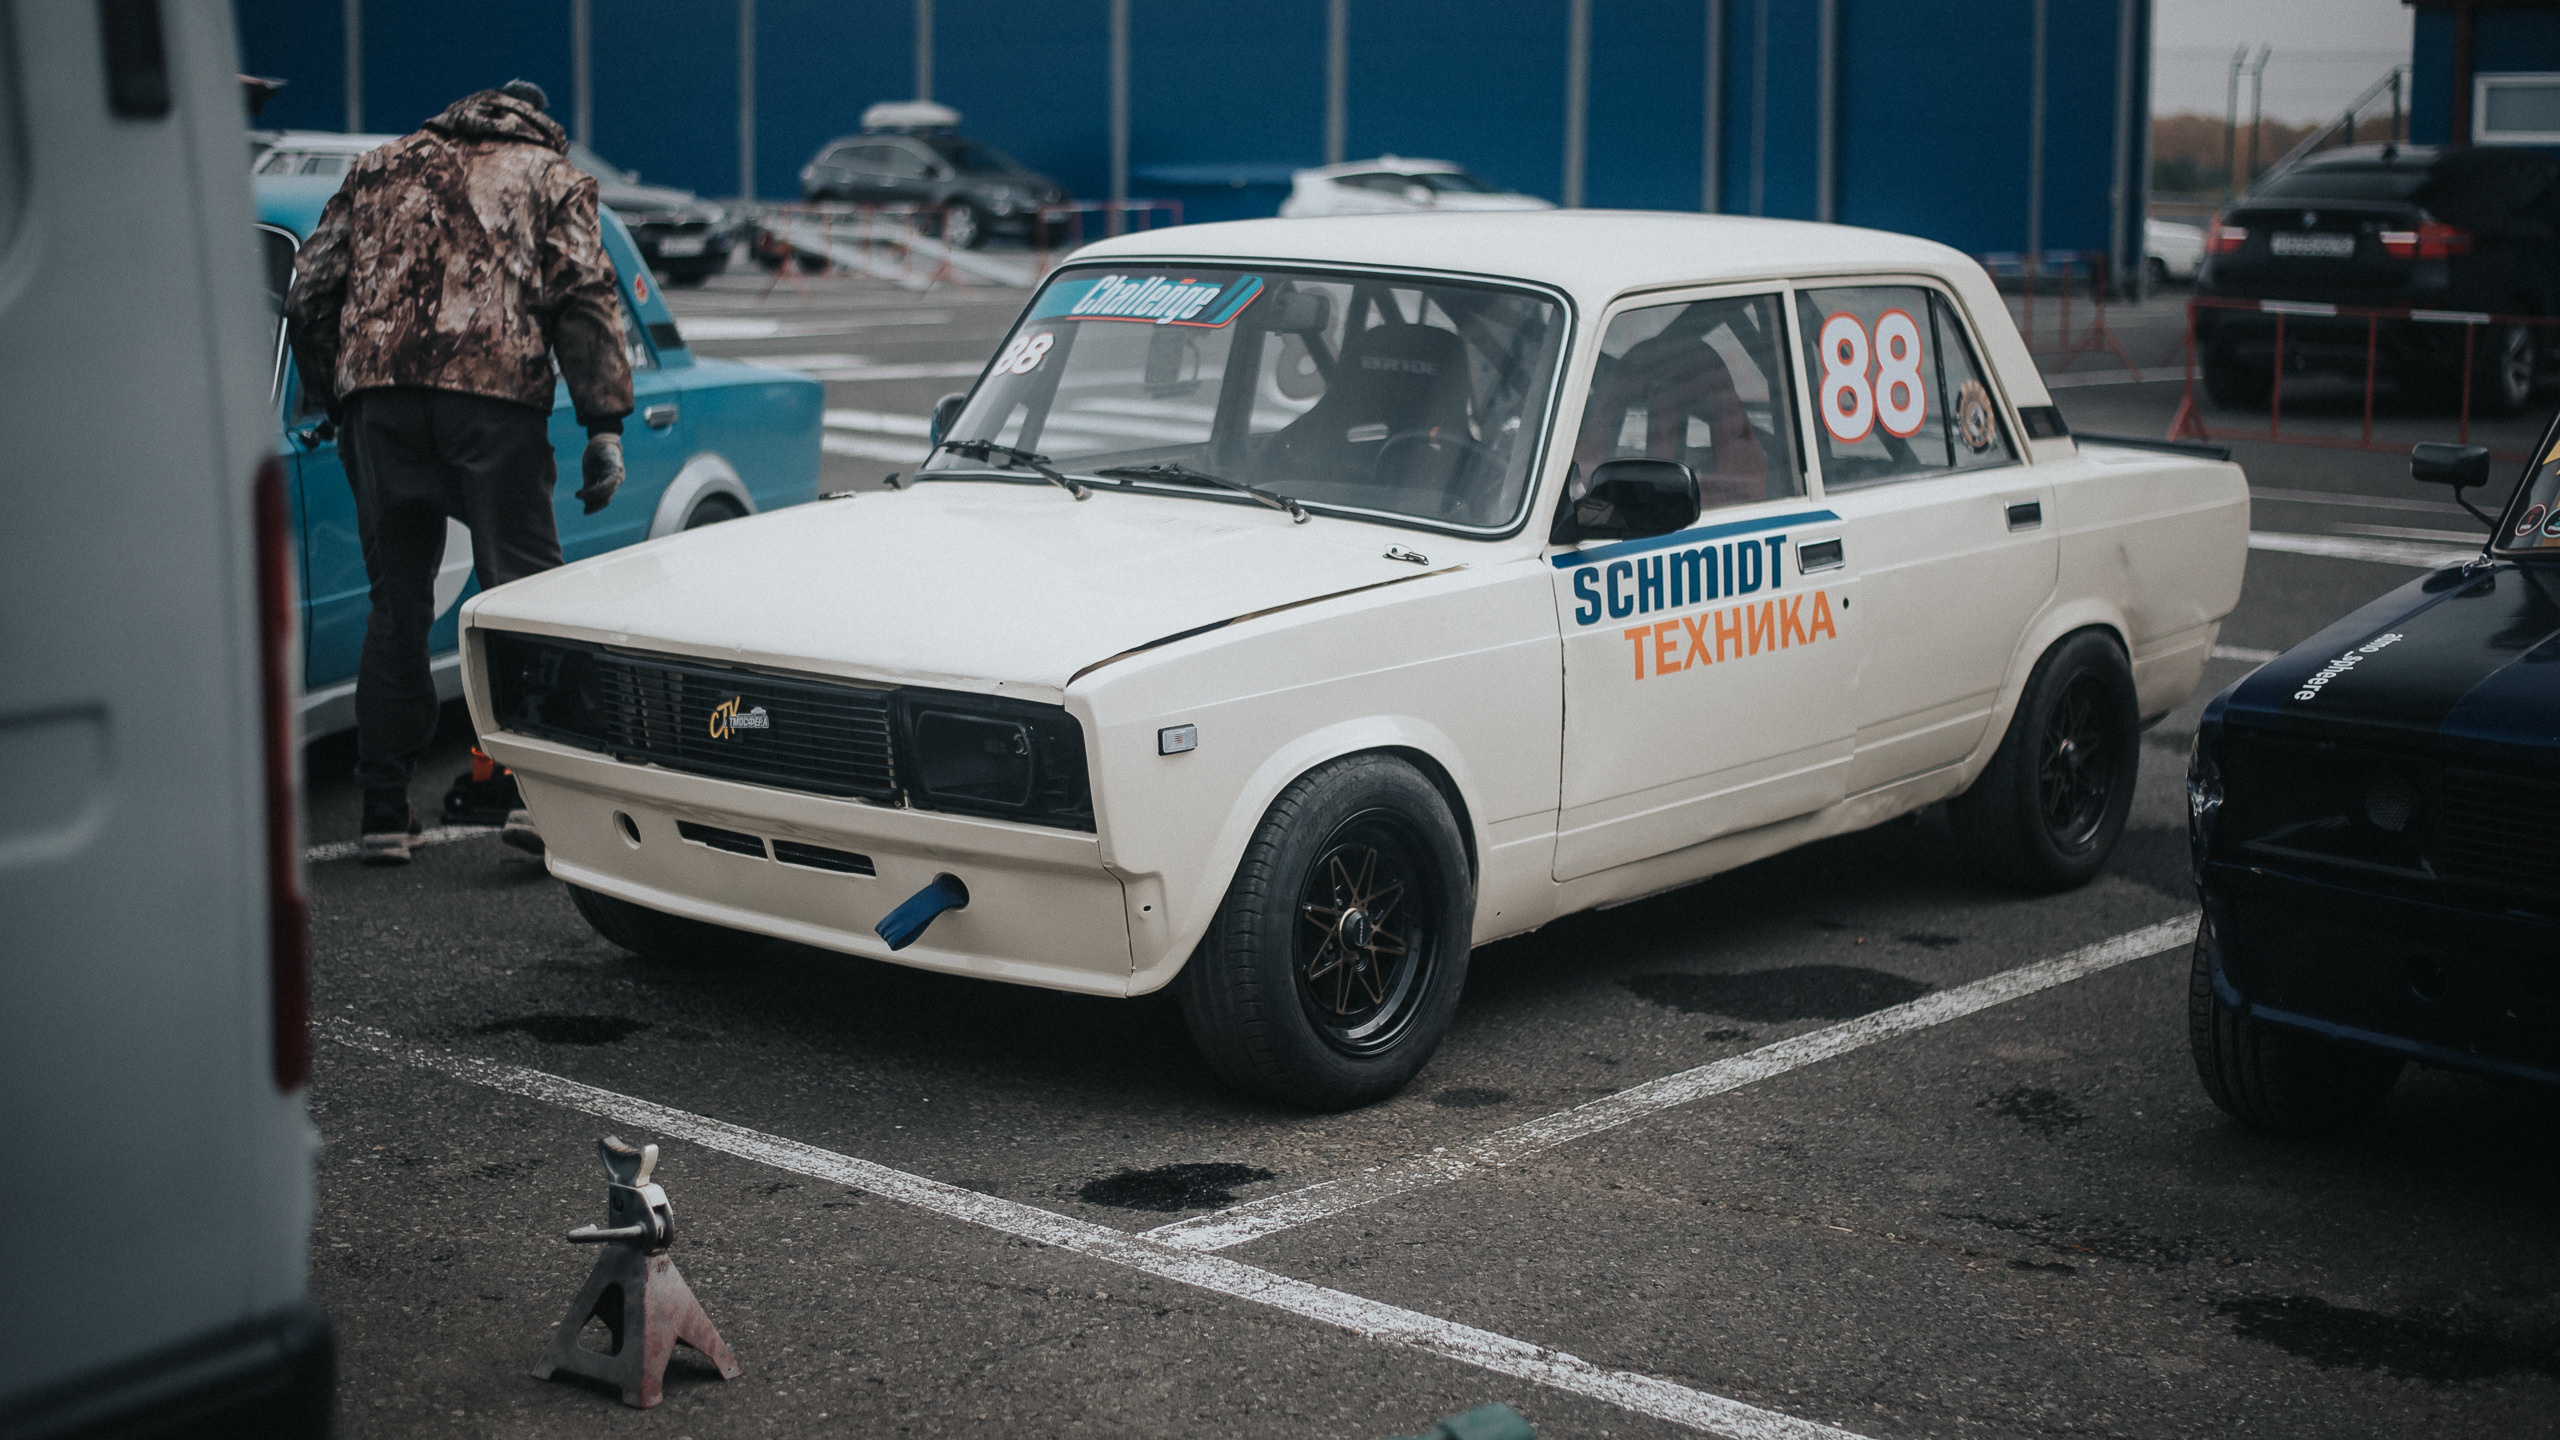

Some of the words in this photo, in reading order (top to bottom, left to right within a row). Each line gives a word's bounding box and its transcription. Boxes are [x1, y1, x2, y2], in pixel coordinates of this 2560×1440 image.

[1071, 274, 1221, 324] Challenge
[993, 332, 1054, 377] 88
[1818, 308, 1928, 444] 88
[1573, 534, 1787, 626] SCHMIDT
[1624, 590, 1837, 681] ТЕХНИКА
